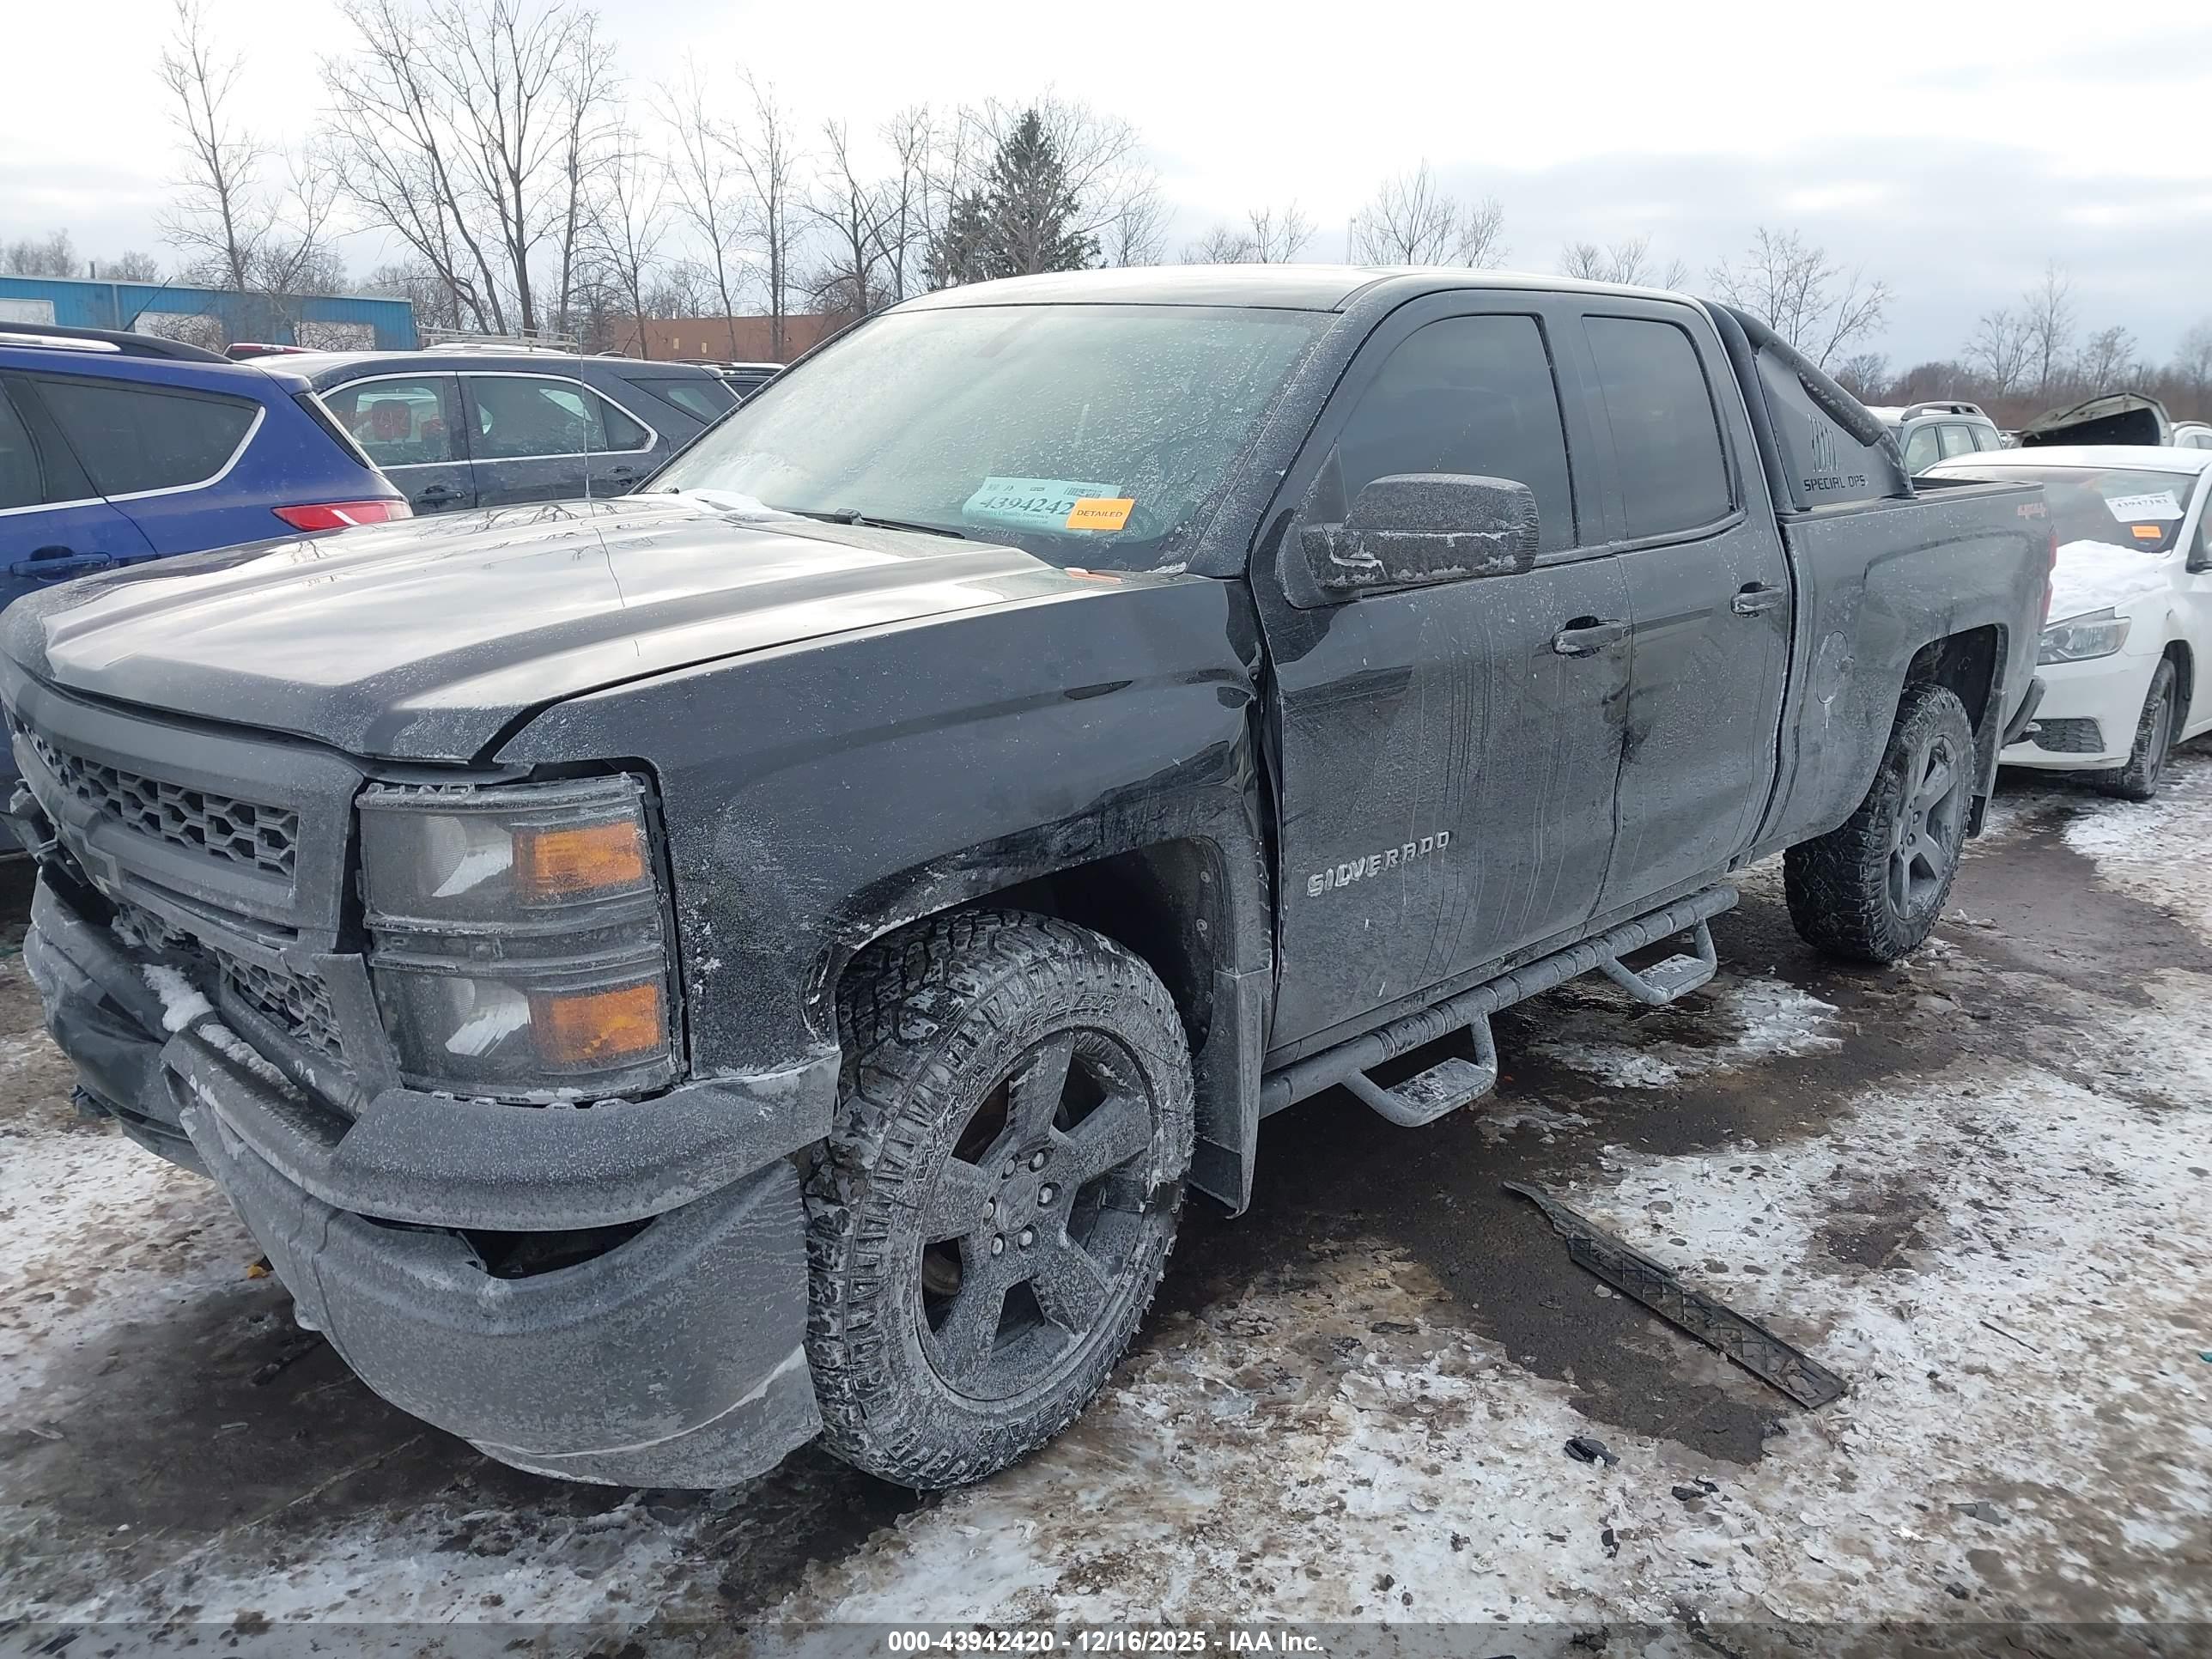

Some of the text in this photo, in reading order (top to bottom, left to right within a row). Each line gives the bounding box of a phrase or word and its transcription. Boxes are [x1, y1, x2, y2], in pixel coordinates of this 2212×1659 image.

[1803, 474, 1867, 492] SPECIAL OPS
[1076, 508, 1123, 519] DETAILED
[1306, 830, 1450, 897] SILVERADO
